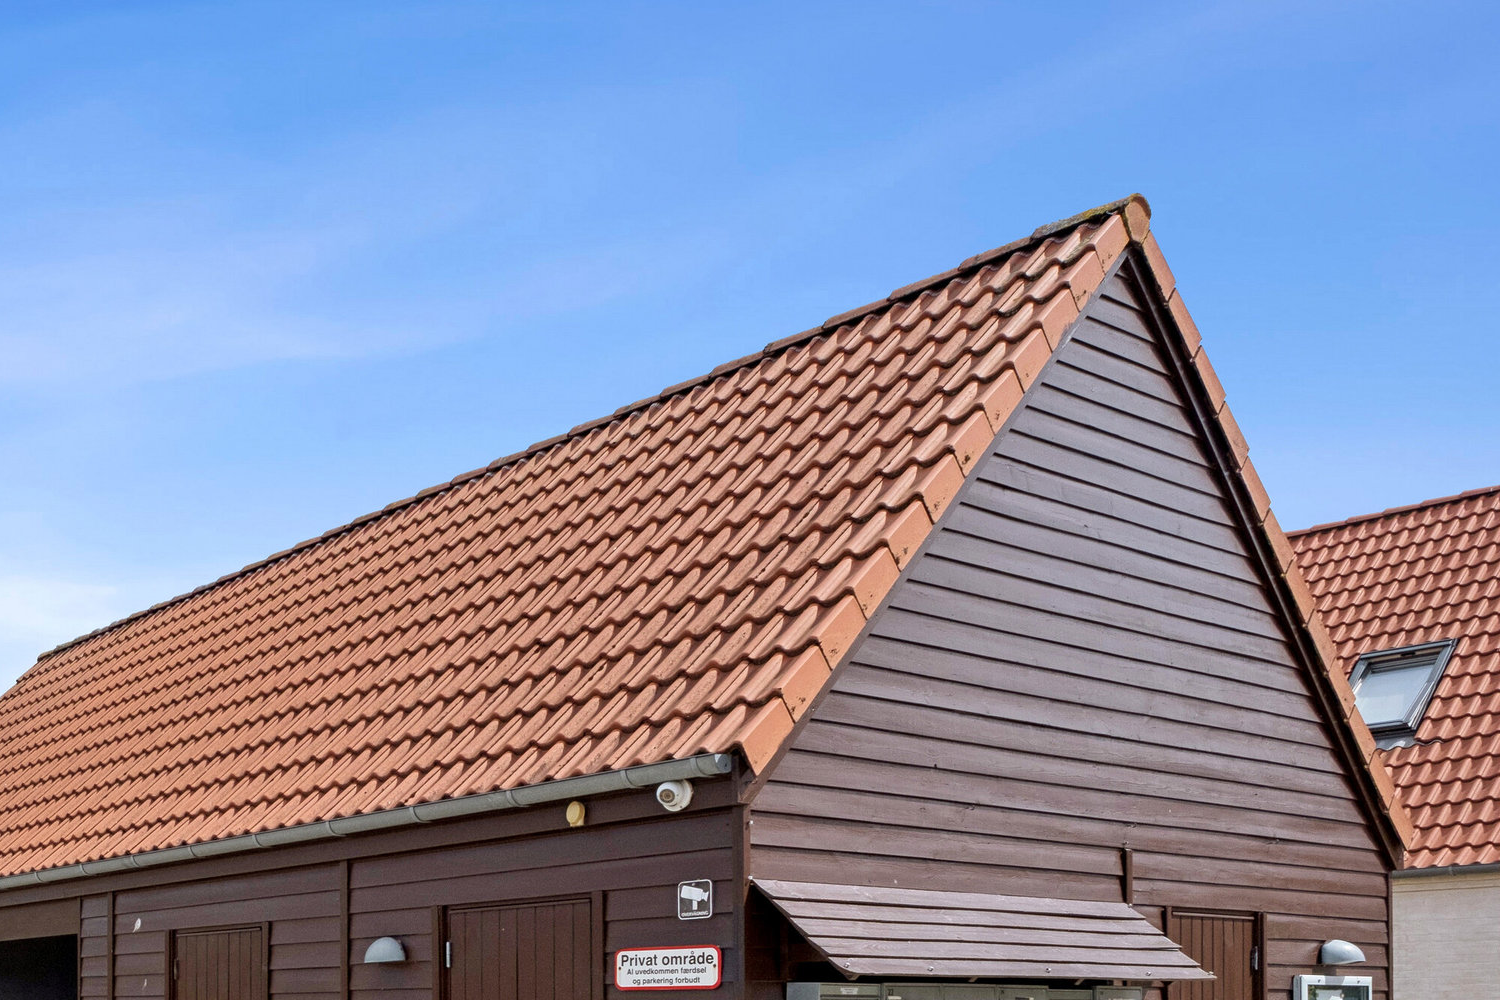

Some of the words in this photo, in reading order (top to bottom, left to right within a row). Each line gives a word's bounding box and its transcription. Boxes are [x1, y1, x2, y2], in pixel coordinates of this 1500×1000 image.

[621, 954, 658, 967] Privat
[662, 951, 714, 965] område
[642, 977, 674, 985] parkering
